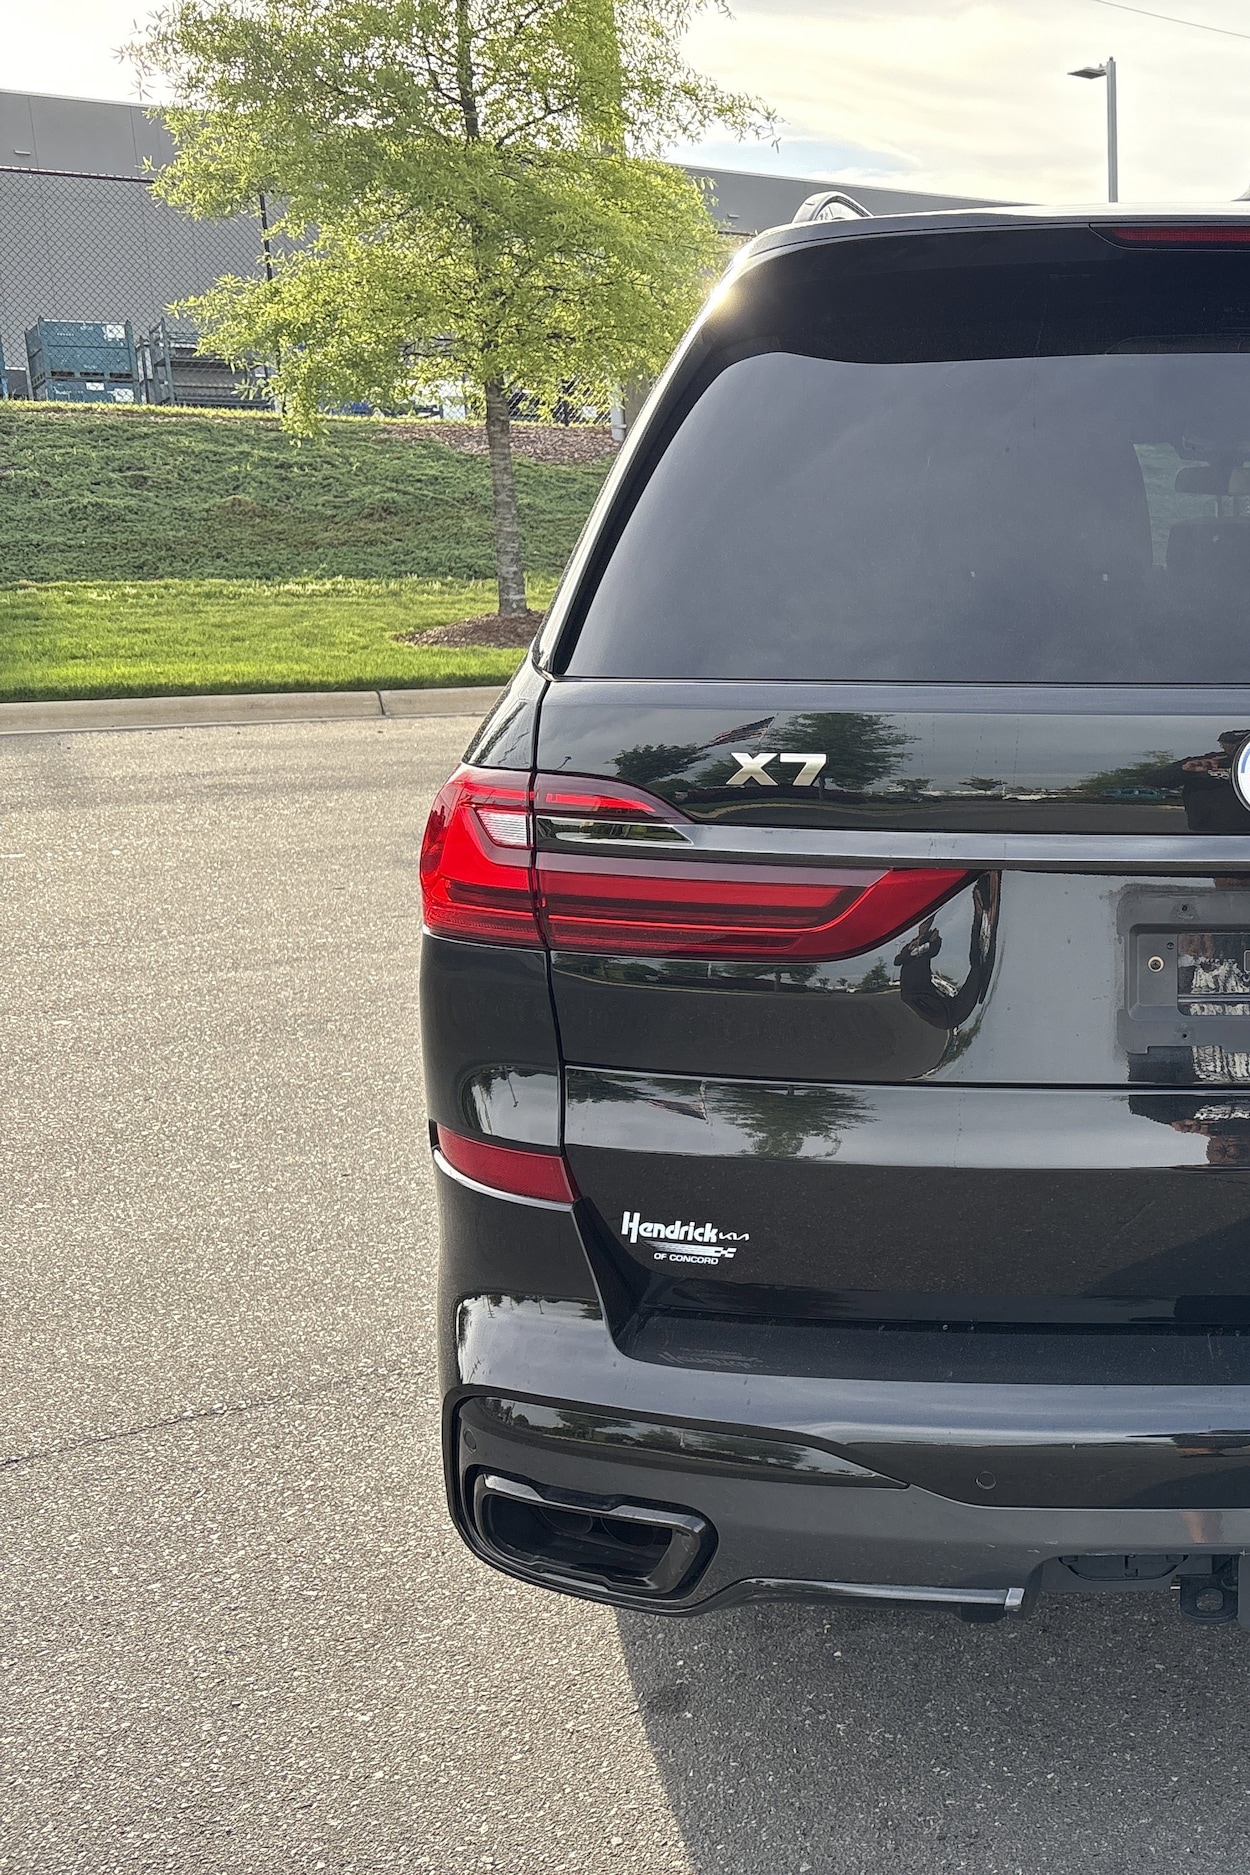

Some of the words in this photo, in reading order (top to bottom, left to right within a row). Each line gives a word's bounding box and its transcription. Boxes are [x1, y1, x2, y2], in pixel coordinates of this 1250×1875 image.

[725, 752, 827, 786] X7
[621, 1211, 719, 1243] Hendrick
[653, 1253, 667, 1261] OF
[668, 1254, 719, 1265] CONCORD
